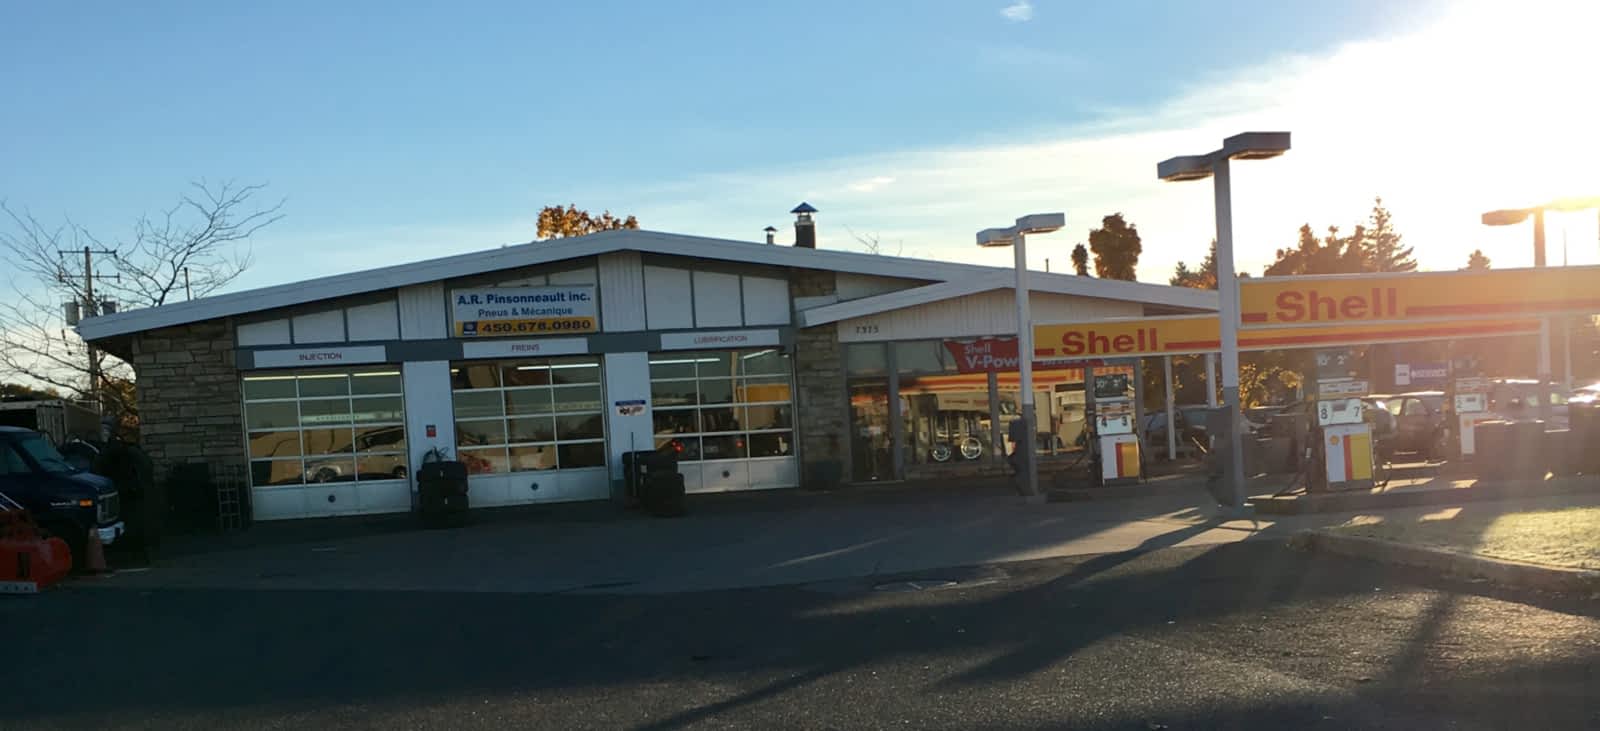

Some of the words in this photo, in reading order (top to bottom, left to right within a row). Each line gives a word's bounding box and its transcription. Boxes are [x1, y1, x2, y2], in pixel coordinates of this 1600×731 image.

[458, 294, 483, 305] A.R.
[487, 292, 565, 304] Pinsonneault
[569, 291, 591, 302] inc.
[1274, 287, 1397, 322] Shell
[478, 308, 508, 318] Pneus
[511, 307, 519, 316] &
[521, 305, 573, 317] Mécanique
[694, 335, 748, 344] LUBRIFICATION
[1061, 328, 1157, 355] Shell
[511, 343, 540, 352] FREINS
[964, 343, 991, 354] Shell
[299, 352, 342, 361] INJECTION
[965, 355, 1019, 368] V-Pow
[1320, 408, 1328, 419] 8
